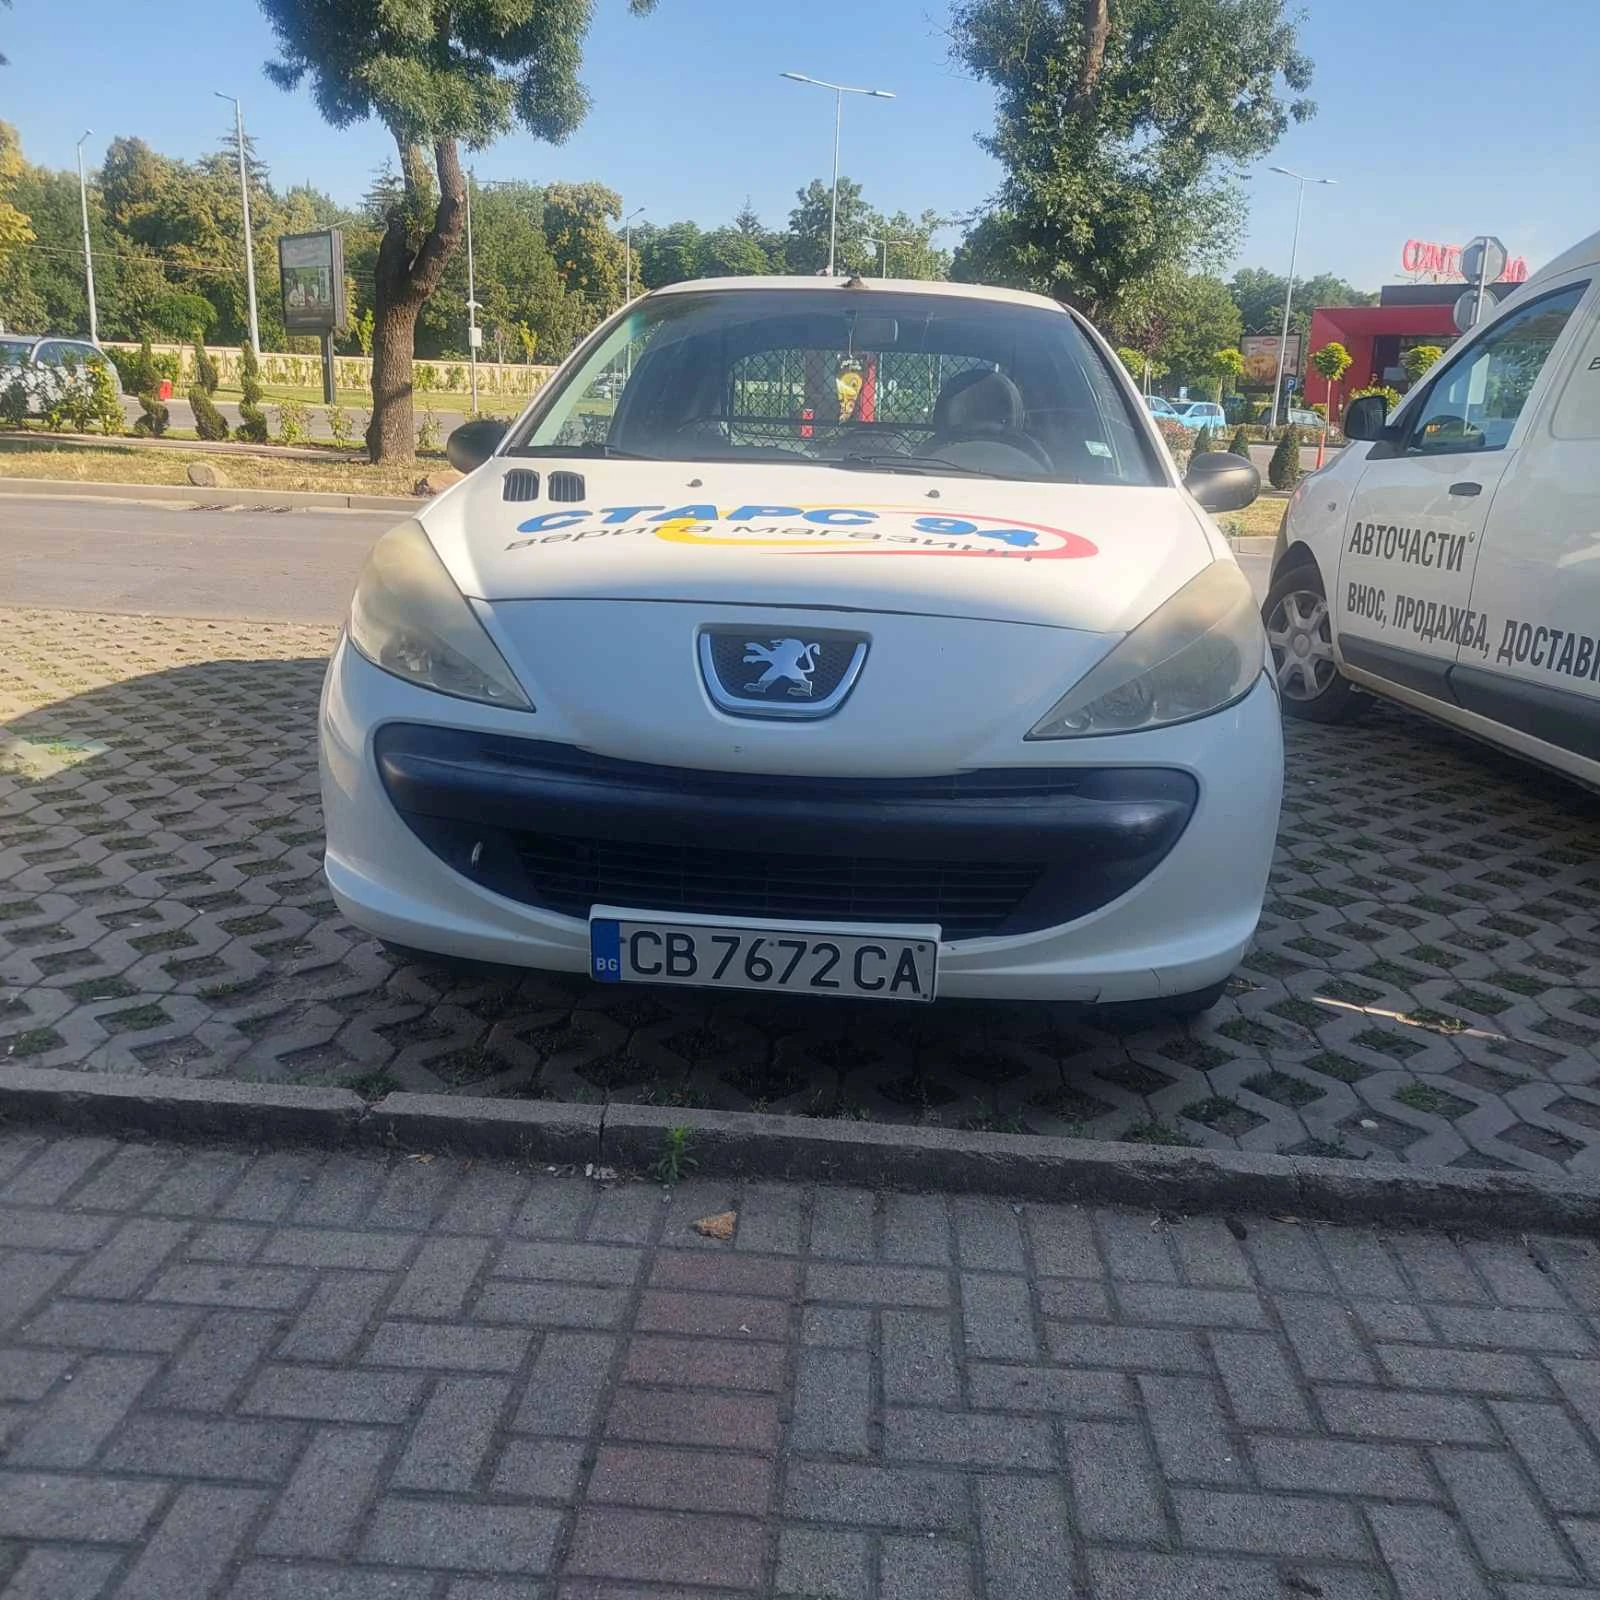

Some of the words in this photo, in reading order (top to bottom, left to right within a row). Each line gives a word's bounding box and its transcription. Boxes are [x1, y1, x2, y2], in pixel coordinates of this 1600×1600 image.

[503, 525, 712, 551] верига
[516, 504, 880, 533] СТАРС
[911, 516, 1040, 547] 94
[1348, 521, 1466, 572] АВТОЧАСТИ
[1347, 582, 1387, 629] ВНОС,
[1392, 594, 1490, 659] ПРОДАЖБА,
[595, 957, 620, 972] BG
